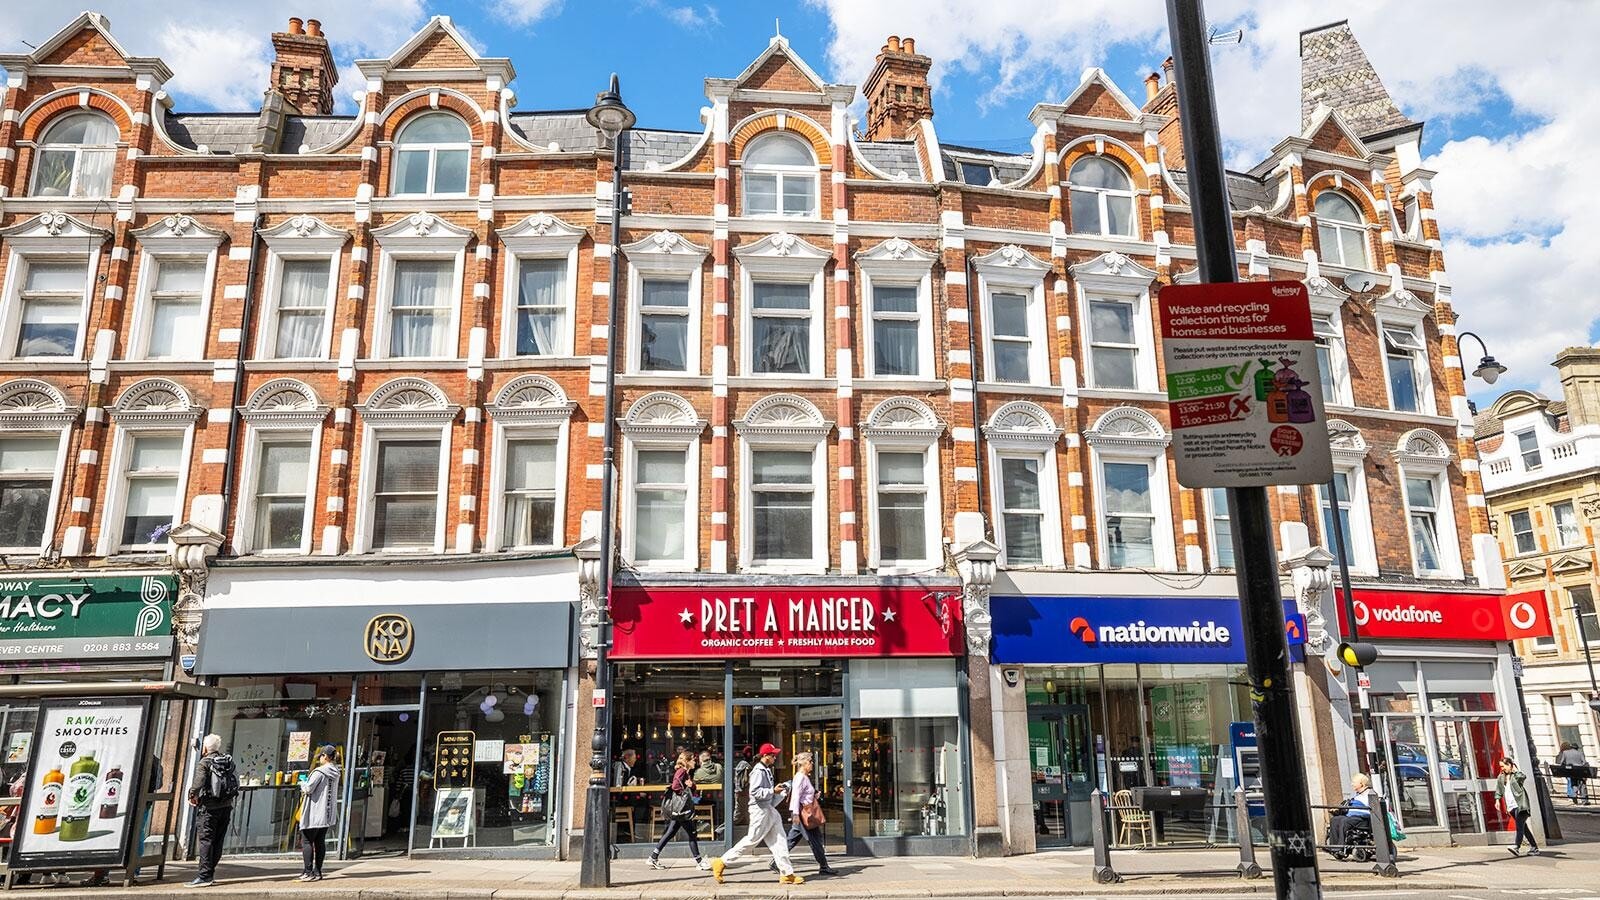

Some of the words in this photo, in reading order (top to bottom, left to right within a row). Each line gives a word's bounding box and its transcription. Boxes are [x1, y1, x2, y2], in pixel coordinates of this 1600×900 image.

[1168, 305, 1202, 315] Waste
[1203, 304, 1222, 313] and
[1223, 302, 1270, 314] recycling
[1169, 316, 1220, 326] collection
[1220, 314, 1251, 323] times
[1252, 313, 1268, 322] for
[1171, 328, 1207, 337] homes
[1208, 326, 1228, 335] and
[1229, 324, 1287, 335] businesses
[1173, 346, 1194, 354] Please
[1194, 346, 1205, 354] put
[1238, 344, 1266, 352] recycling
[1289, 349, 1301, 357] day
[1176, 377, 1196, 385] 12:00
[1207, 413, 1228, 423] 12:00
[701, 597, 755, 632] PRET
[763, 597, 778, 632] A
[788, 597, 875, 632] MANGER
[1372, 605, 1443, 623] vodafone
[12, 621, 57, 633] Healthcare
[1099, 620, 1230, 642] nationwide
[83, 643, 109, 653] 0208
[112, 642, 132, 651] 883
[134, 642, 160, 651] 5564
[701, 638, 741, 647] ORGANIC
[743, 638, 774, 647] COFFEE
[788, 638, 823, 647] FRESHLY
[824, 637, 849, 647] MADE
[850, 637, 876, 646] FOOD
[0, 645, 22, 655] VER
[24, 644, 65, 654] CENTRE
[66, 716, 95, 725] RAW
[95, 715, 123, 727] crafted
[55, 726, 128, 737] SMOOTHIES
